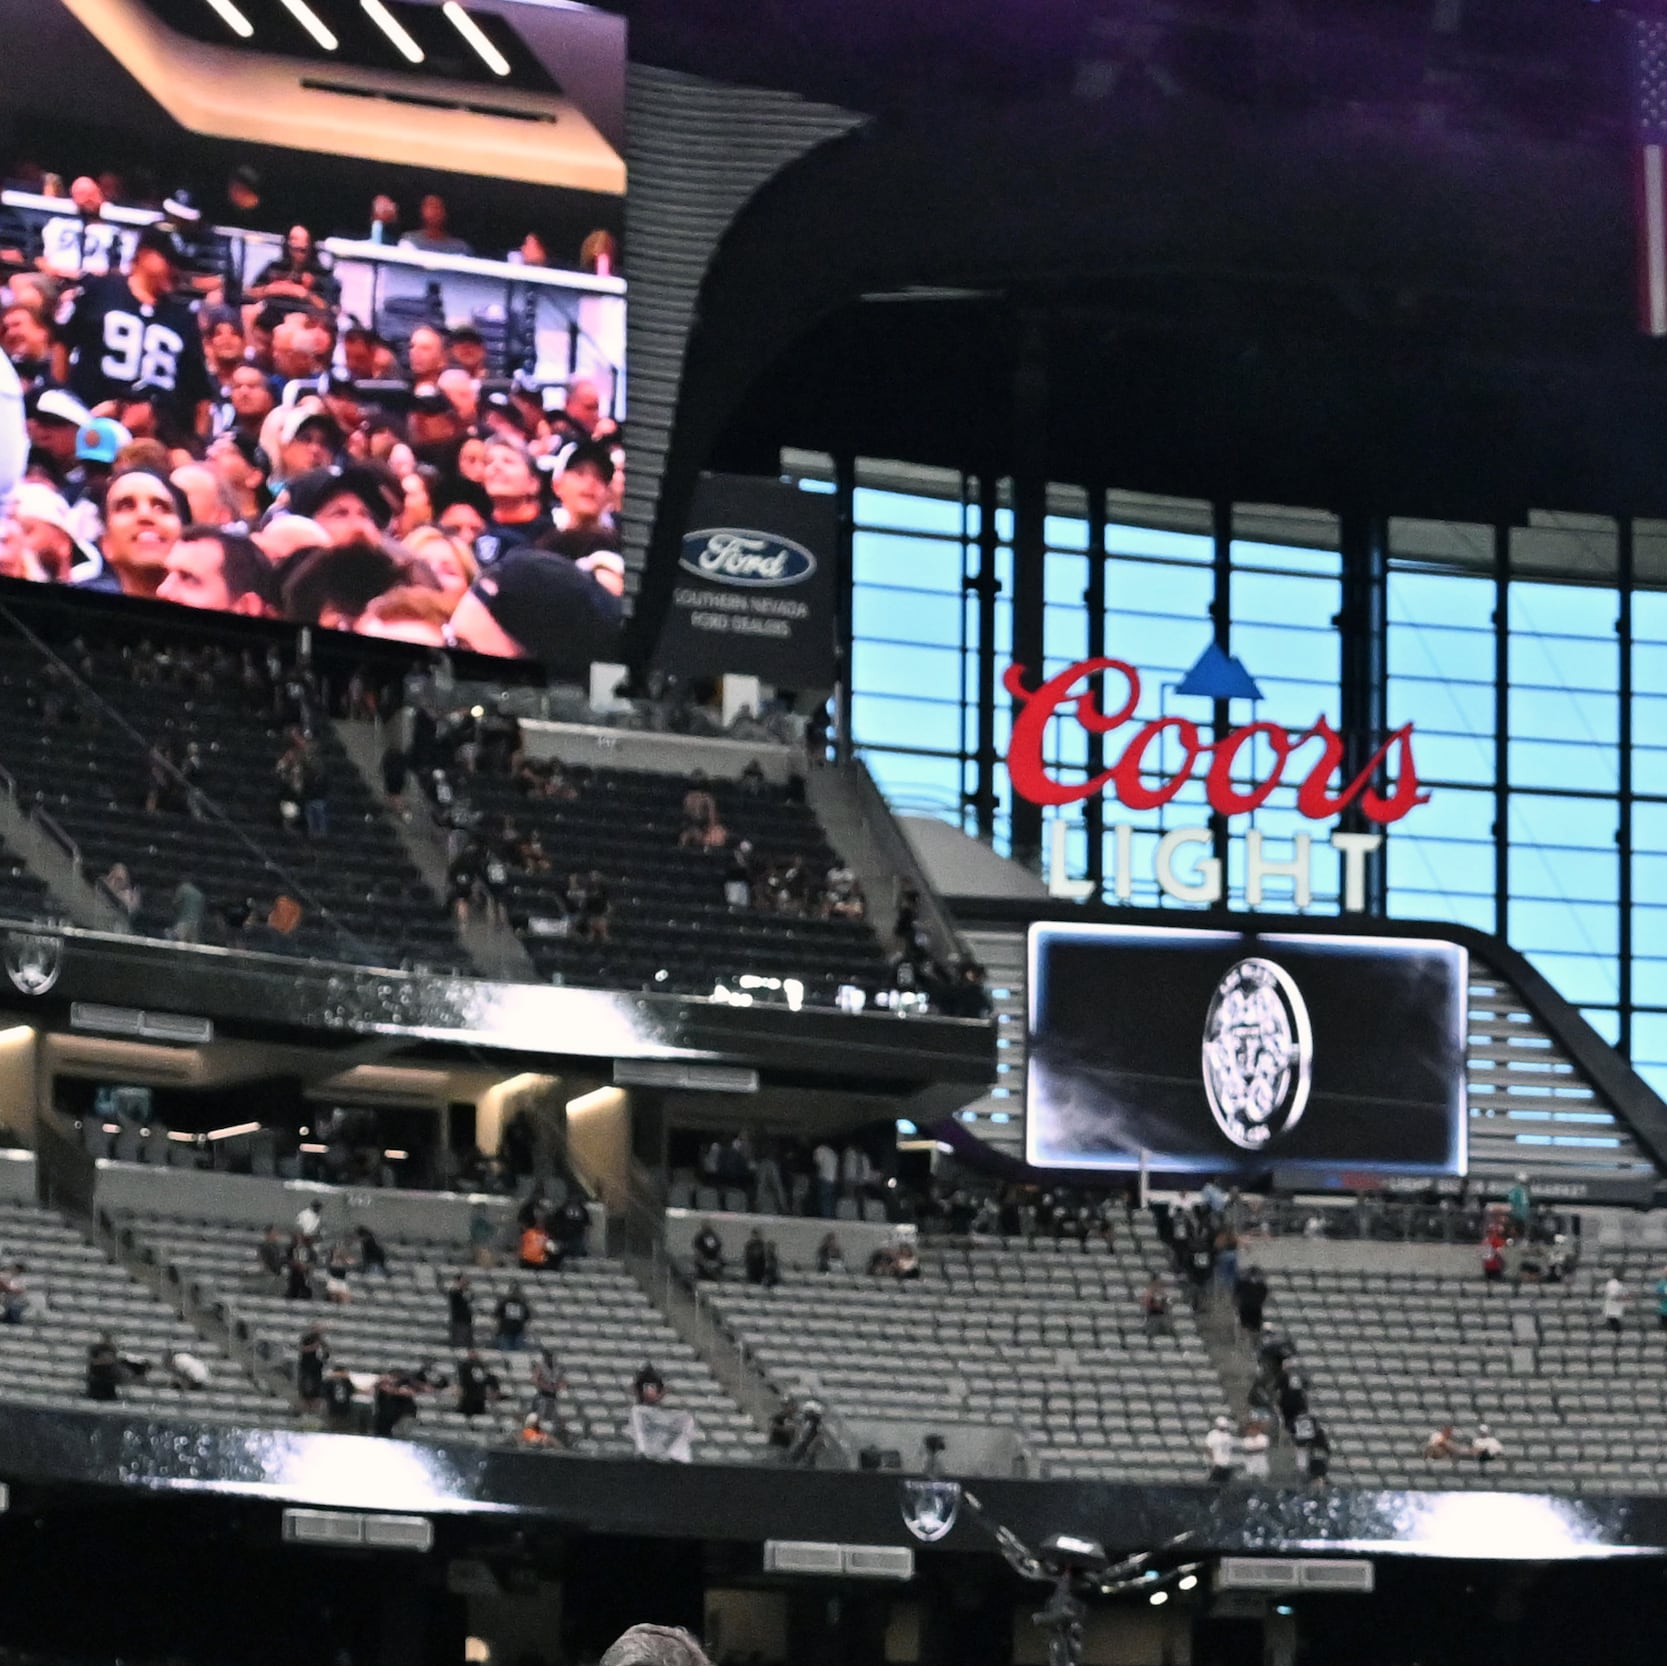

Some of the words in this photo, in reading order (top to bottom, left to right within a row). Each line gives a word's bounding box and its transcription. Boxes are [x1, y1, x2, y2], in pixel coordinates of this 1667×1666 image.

[101, 310, 184, 391] 96
[697, 533, 790, 578] Ford
[1003, 657, 1433, 824] Coors
[1048, 820, 1382, 912] LIGHT
